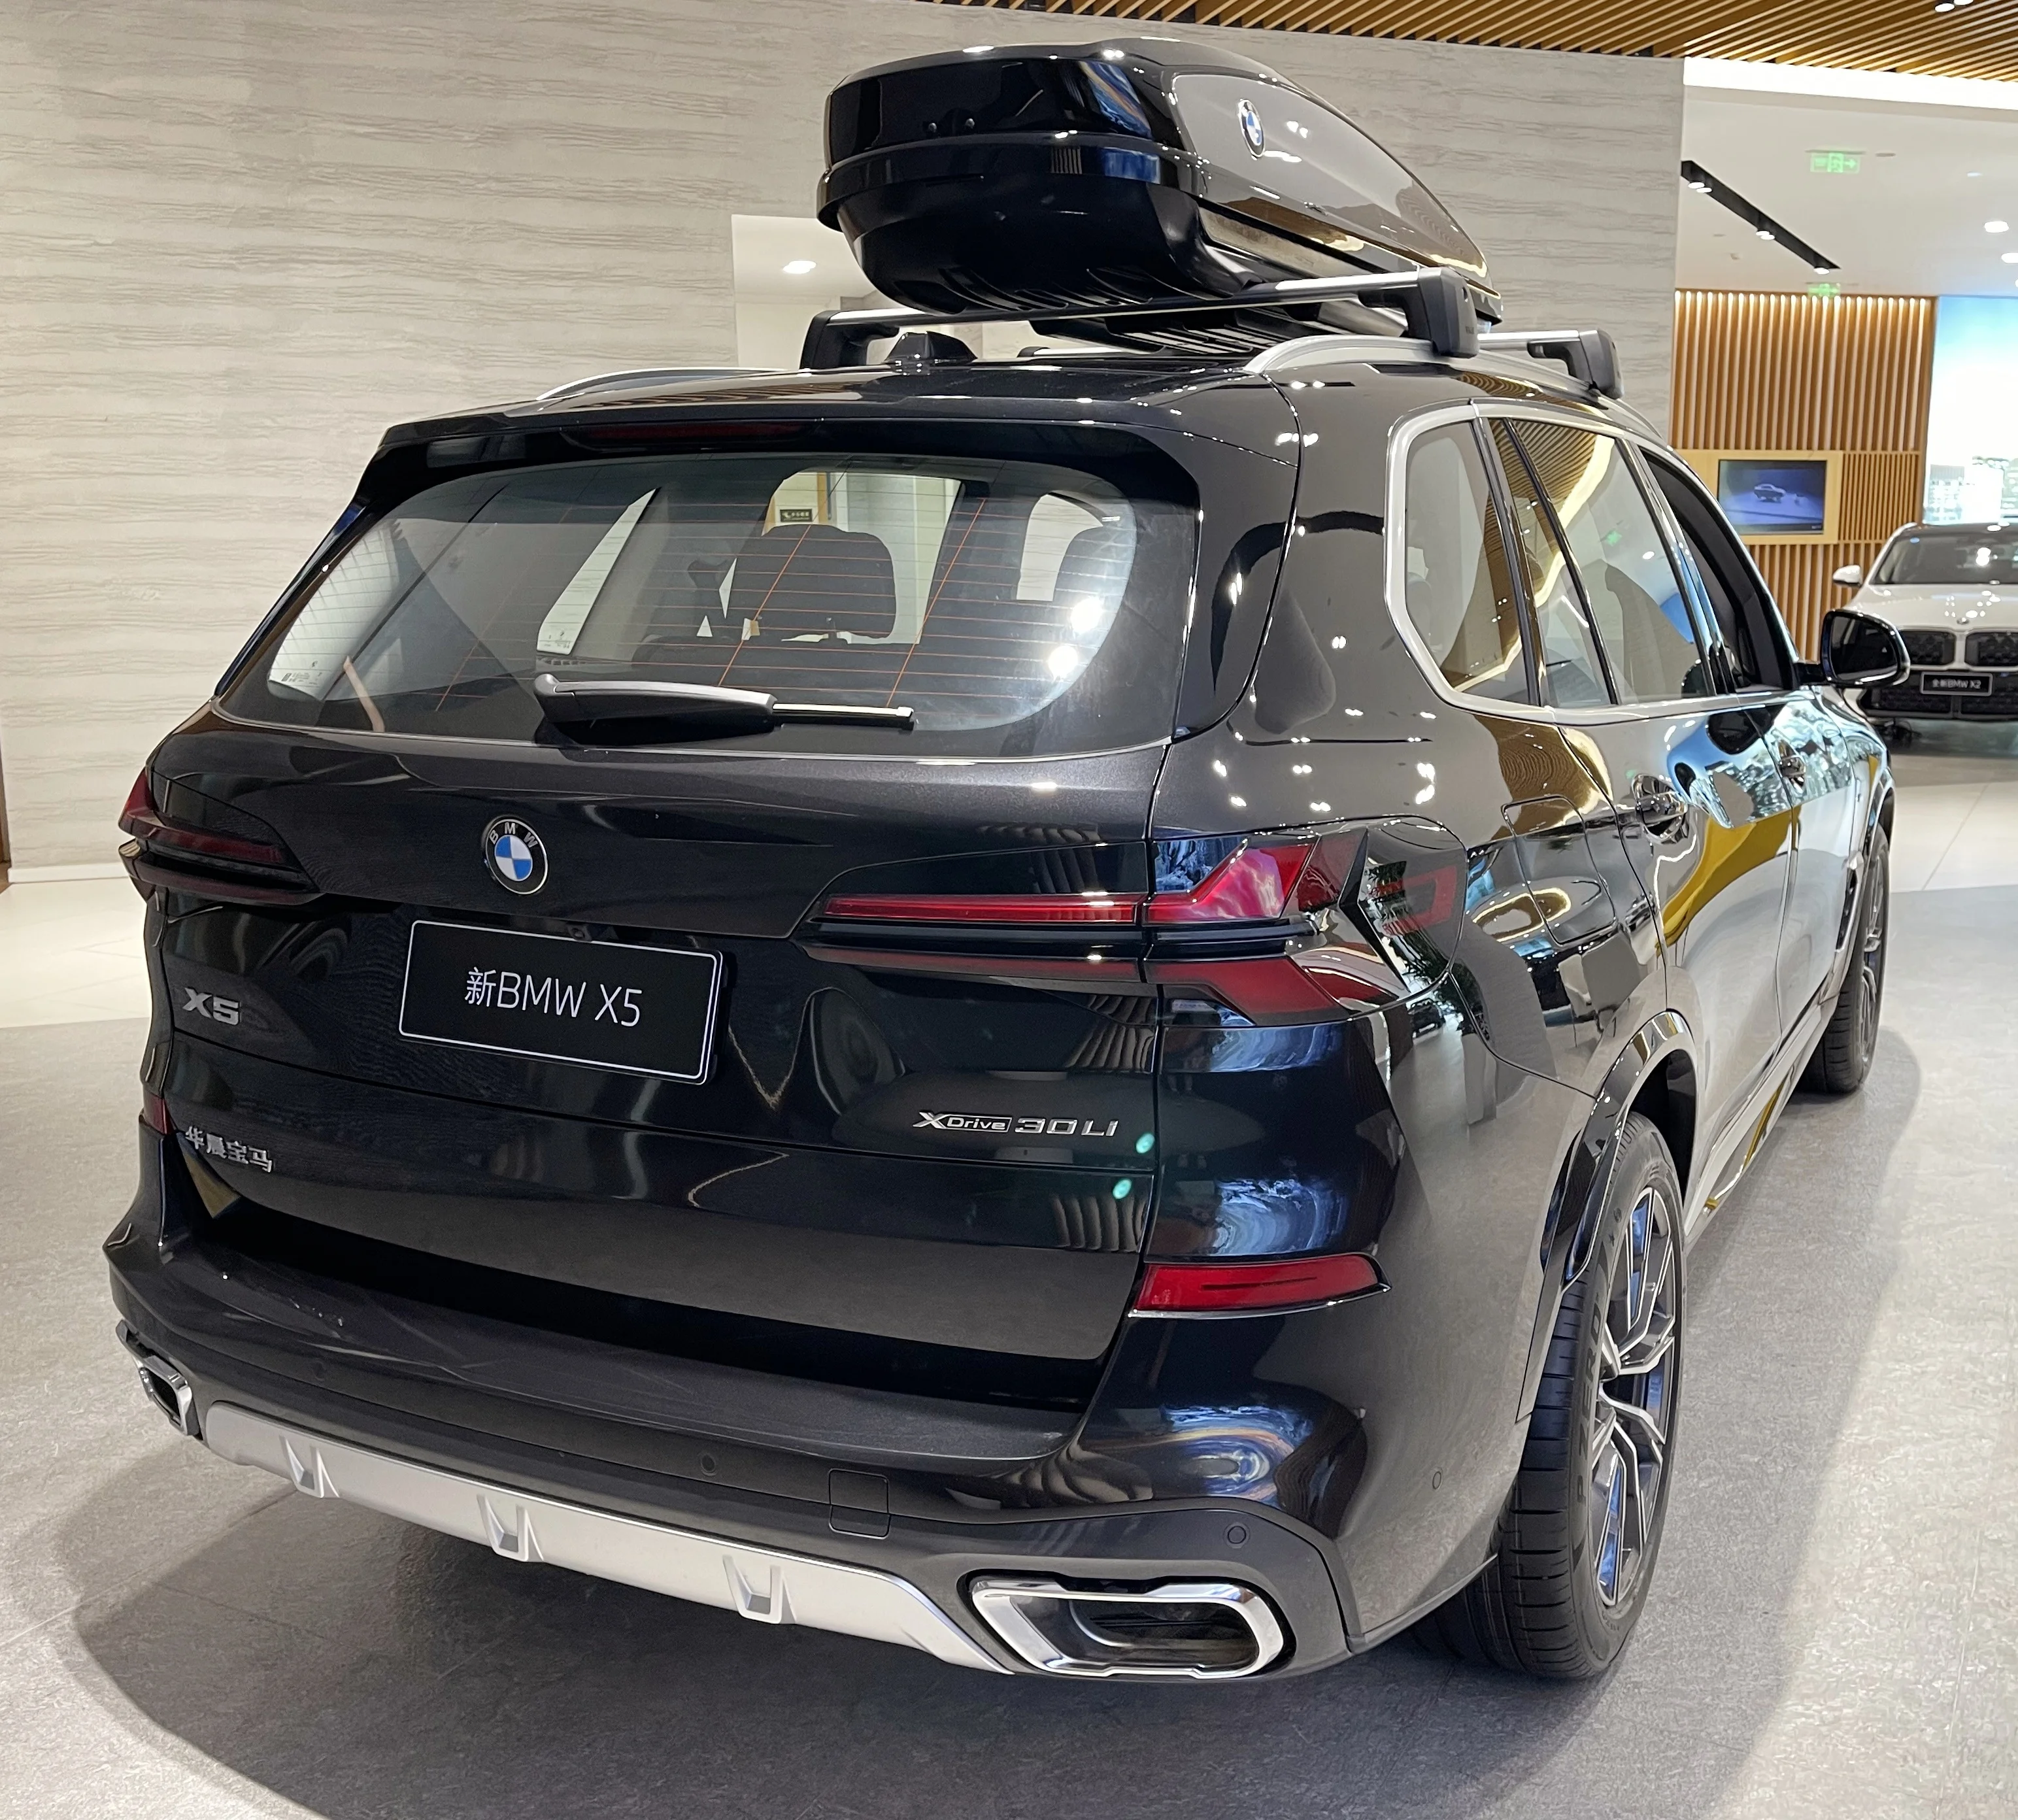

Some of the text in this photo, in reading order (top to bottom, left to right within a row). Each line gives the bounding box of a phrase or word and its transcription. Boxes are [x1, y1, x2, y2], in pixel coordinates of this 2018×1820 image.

[489, 822, 538, 848] BMW
[182, 987, 240, 1025] X5
[465, 967, 642, 1026] 新BMW X5
